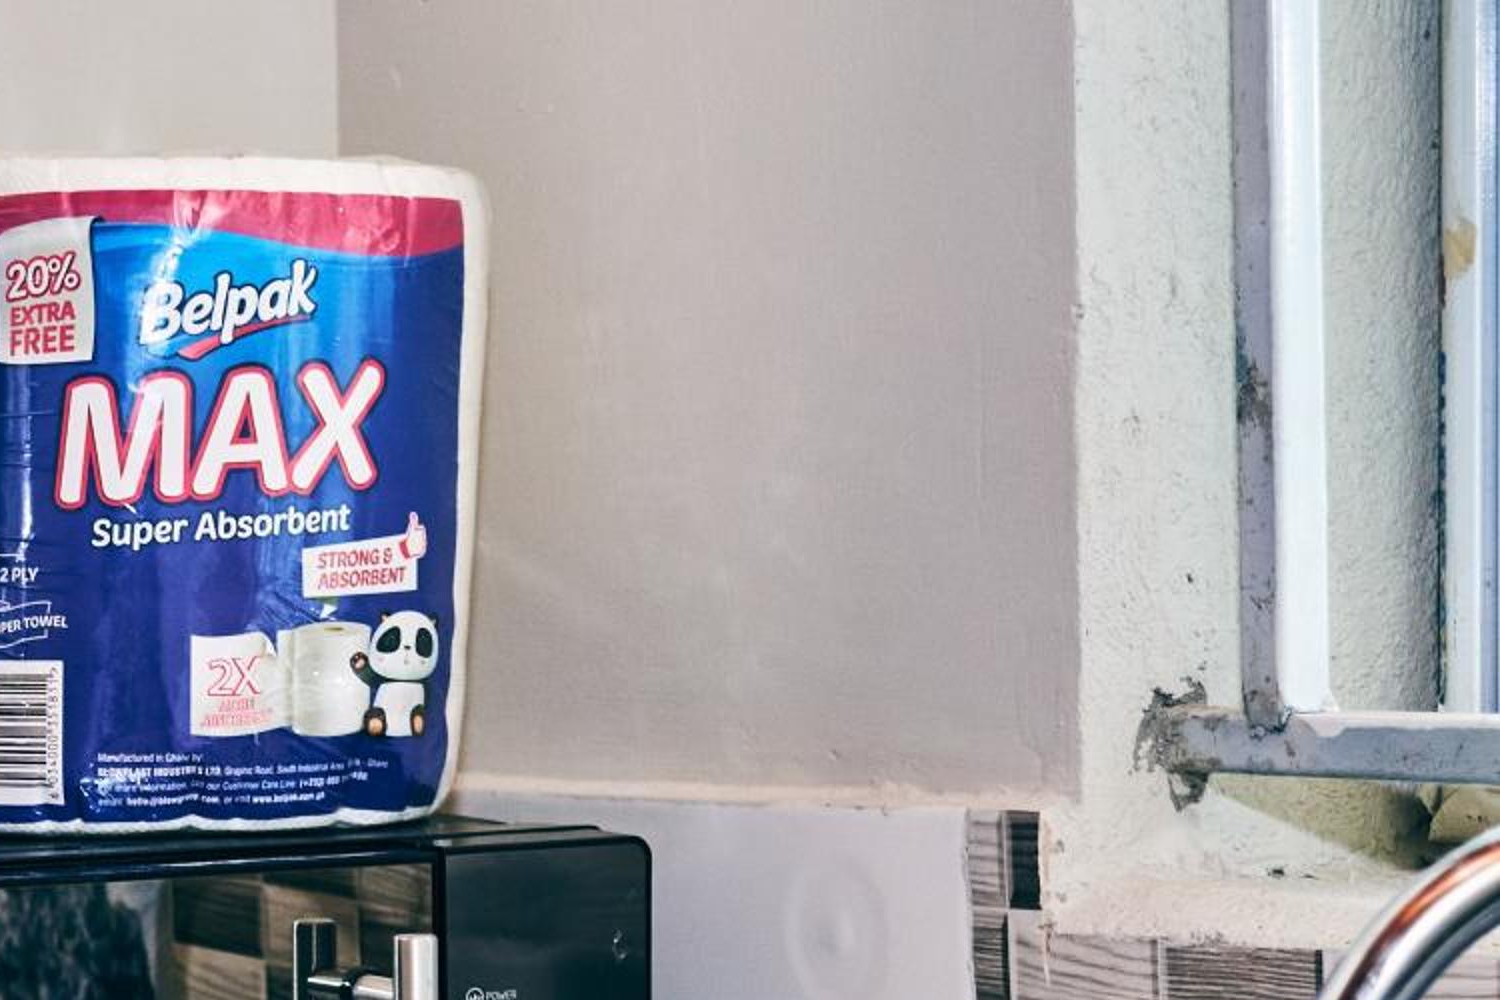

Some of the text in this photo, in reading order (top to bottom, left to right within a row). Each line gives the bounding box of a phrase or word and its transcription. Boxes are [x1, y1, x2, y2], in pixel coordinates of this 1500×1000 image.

[6, 251, 80, 303] 20%
[10, 301, 76, 328] EXTRA
[138, 258, 319, 344] Belpak
[9, 325, 76, 356] FREE
[55, 357, 387, 509] MAX
[91, 504, 351, 551] Super Absorbent
[317, 548, 379, 568] STRONG
[0, 567, 39, 583] 2 PLY
[317, 567, 406, 589] ABSORBENT
[24, 615, 68, 629] TOWEL
[207, 655, 261, 697] 2X
[98, 754, 154, 763] Manufactured
[486, 989, 517, 1000] POWER
